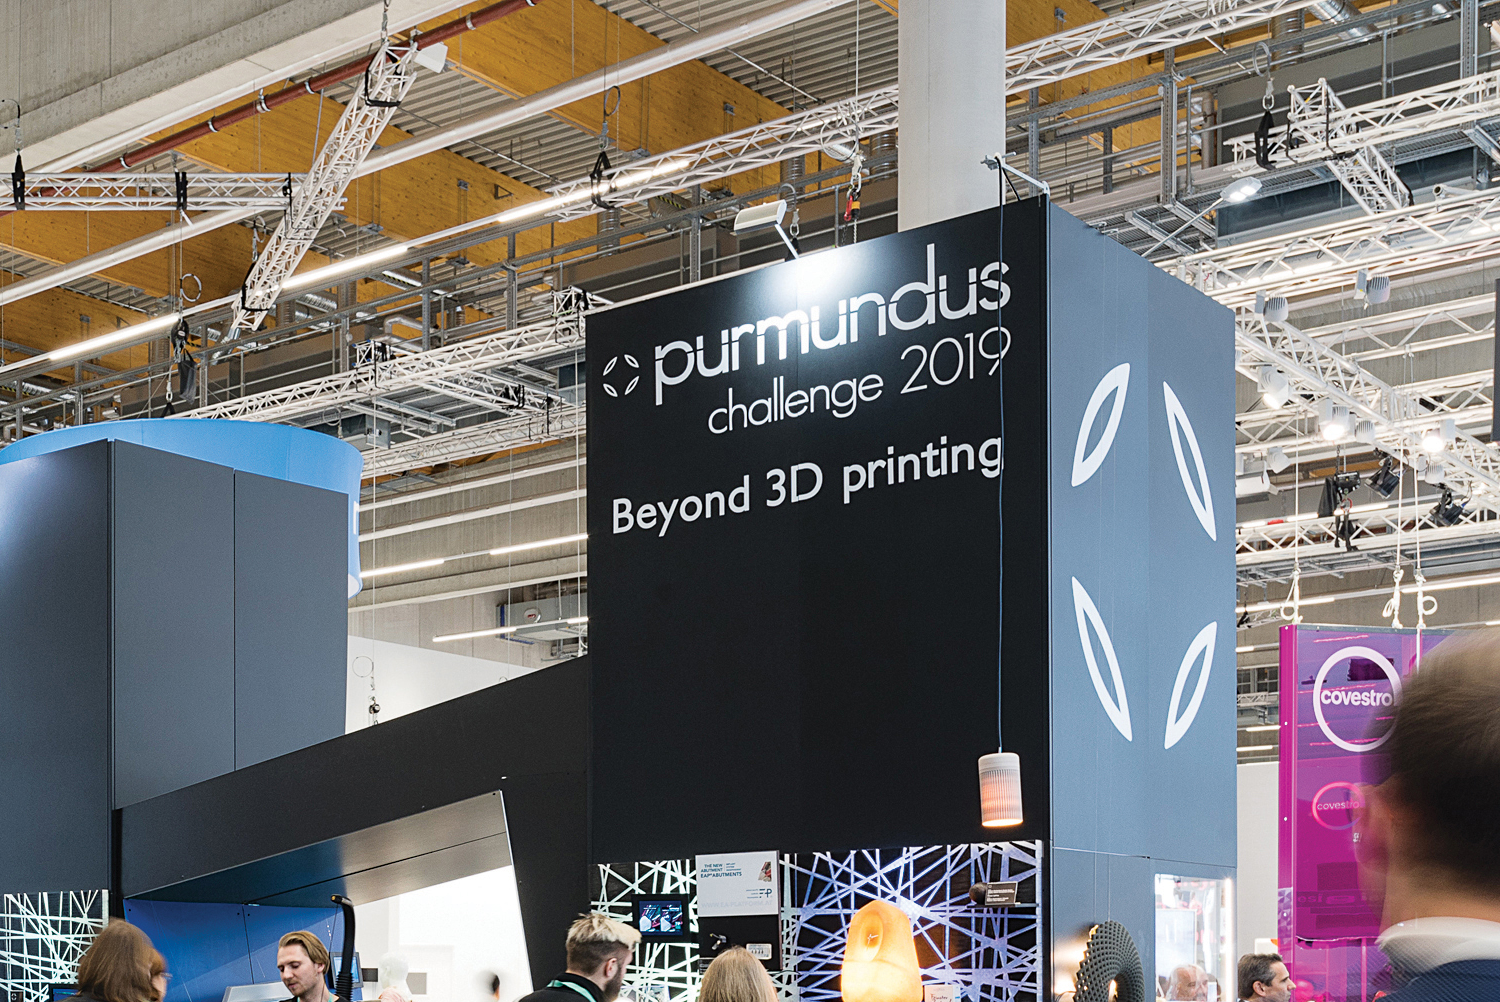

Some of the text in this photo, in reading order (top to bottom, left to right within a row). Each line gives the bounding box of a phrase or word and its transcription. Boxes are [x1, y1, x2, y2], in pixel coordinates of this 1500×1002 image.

[655, 242, 1012, 406] purmundus
[707, 326, 1012, 435] challenge 2019
[612, 435, 1004, 538] Beyond 3D printing
[1320, 689, 1394, 707] covestro
[1316, 799, 1360, 811] covestro
